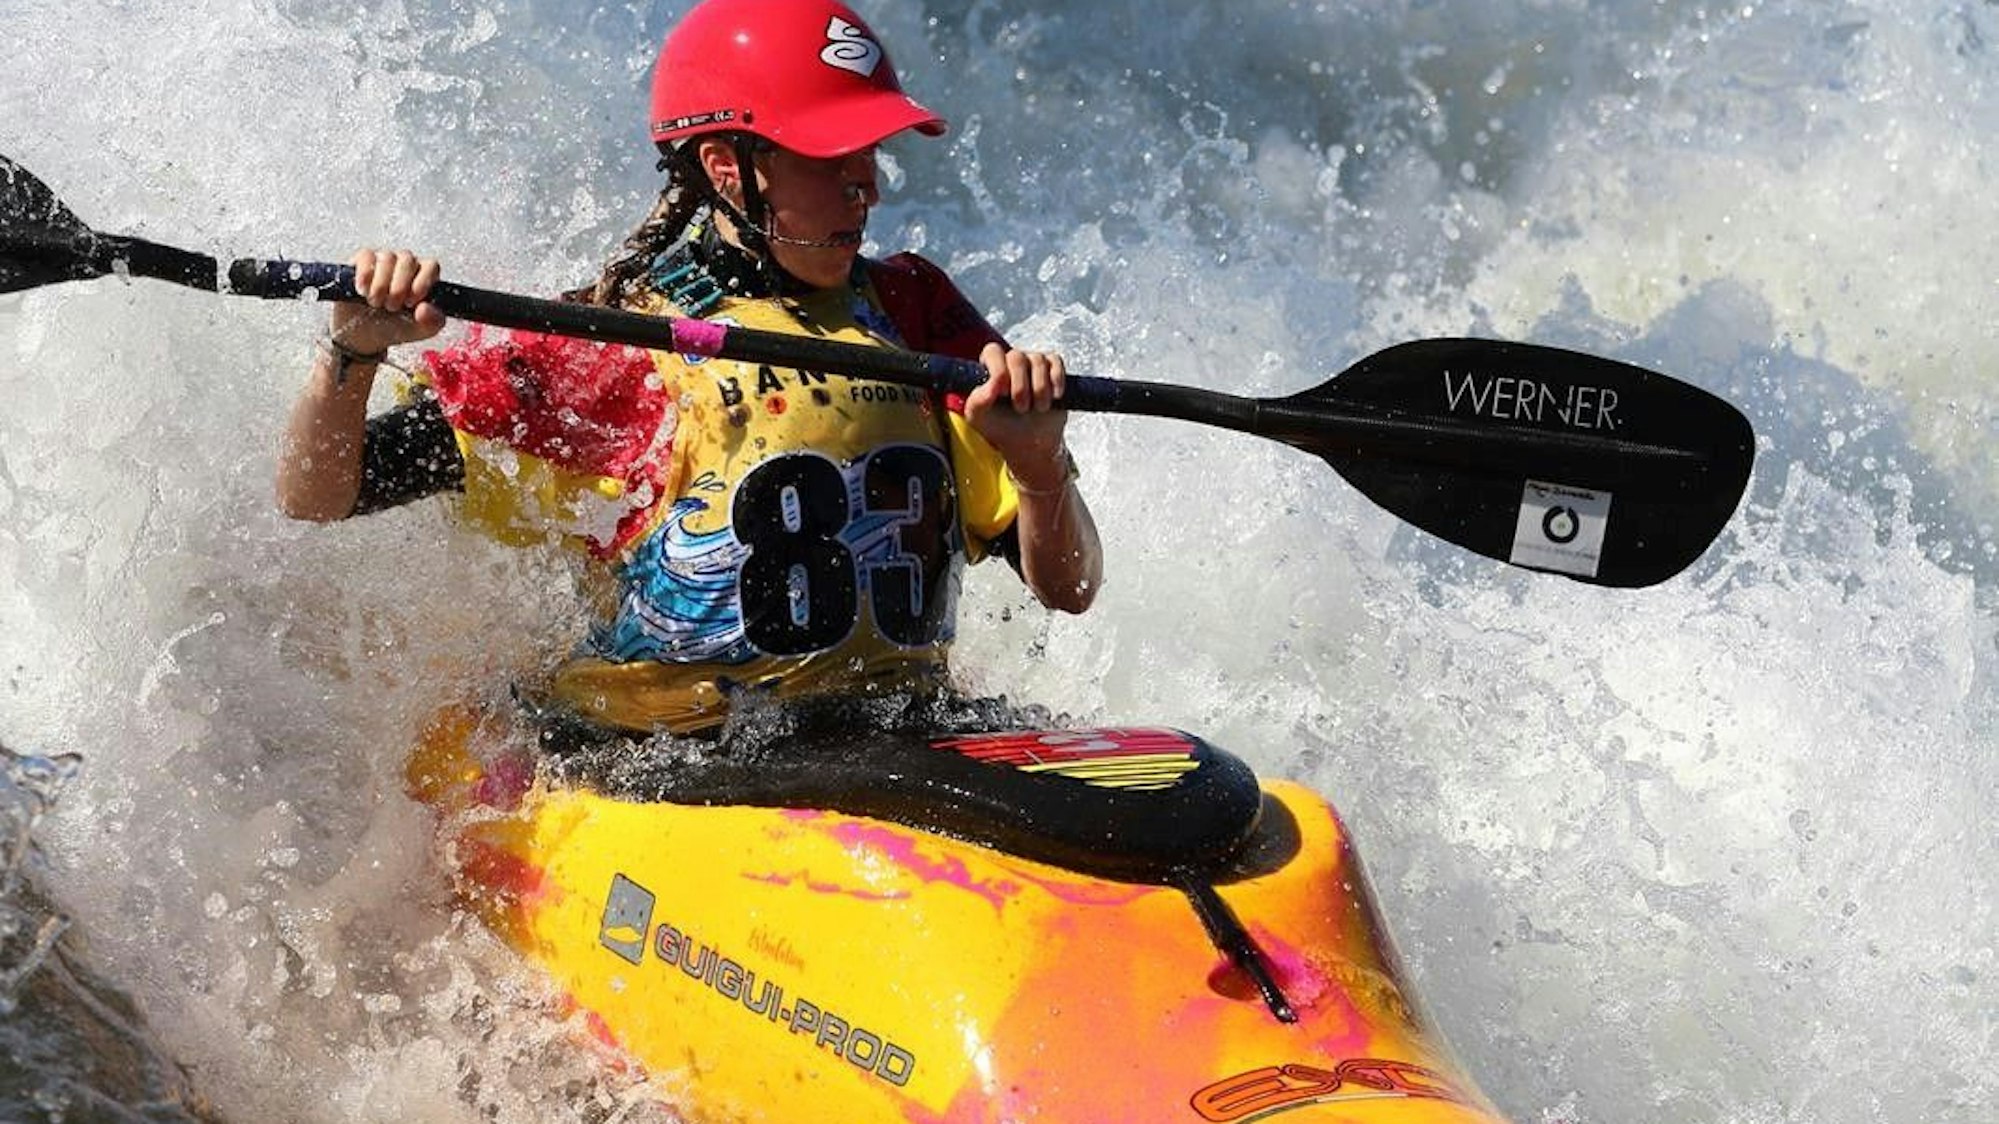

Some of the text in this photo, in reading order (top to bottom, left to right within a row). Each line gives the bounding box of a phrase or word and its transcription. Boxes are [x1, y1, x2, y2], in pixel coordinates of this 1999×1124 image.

[850, 386, 898, 403] FOOD
[731, 441, 956, 657] 83
[653, 922, 916, 1088] GUIGUI-PROD
